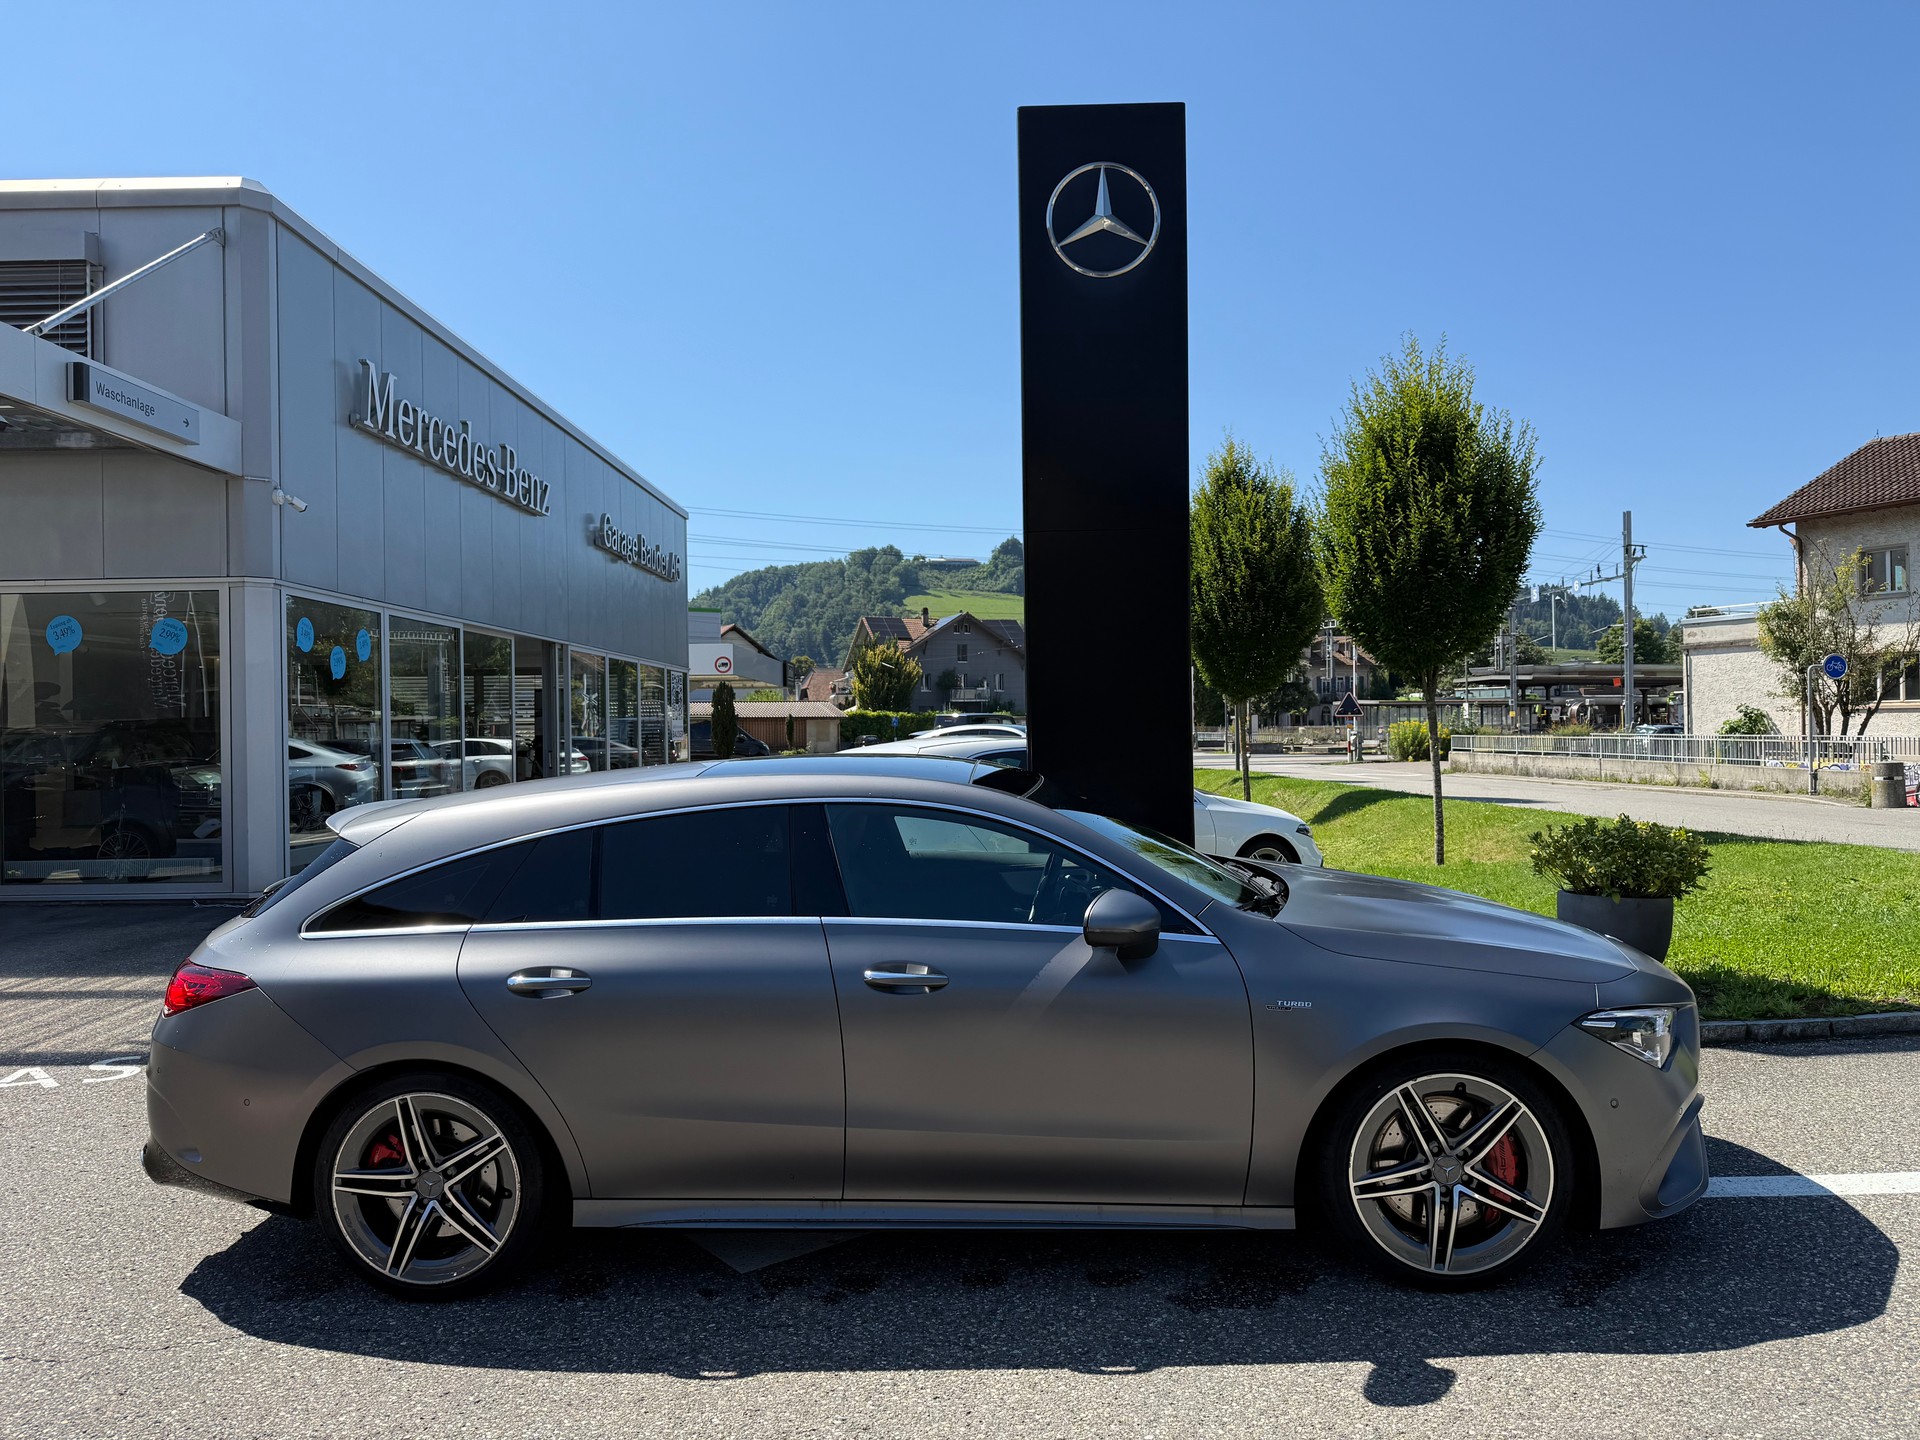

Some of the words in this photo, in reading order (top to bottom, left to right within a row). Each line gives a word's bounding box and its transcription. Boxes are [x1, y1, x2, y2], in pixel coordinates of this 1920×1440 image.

[95, 380, 156, 417] Waschanlage
[360, 358, 551, 517] Mercedes-Benz
[603, 513, 638, 564] Garage
[53, 625, 76, 641] 3.49%
[159, 627, 180, 643] 2.99%
